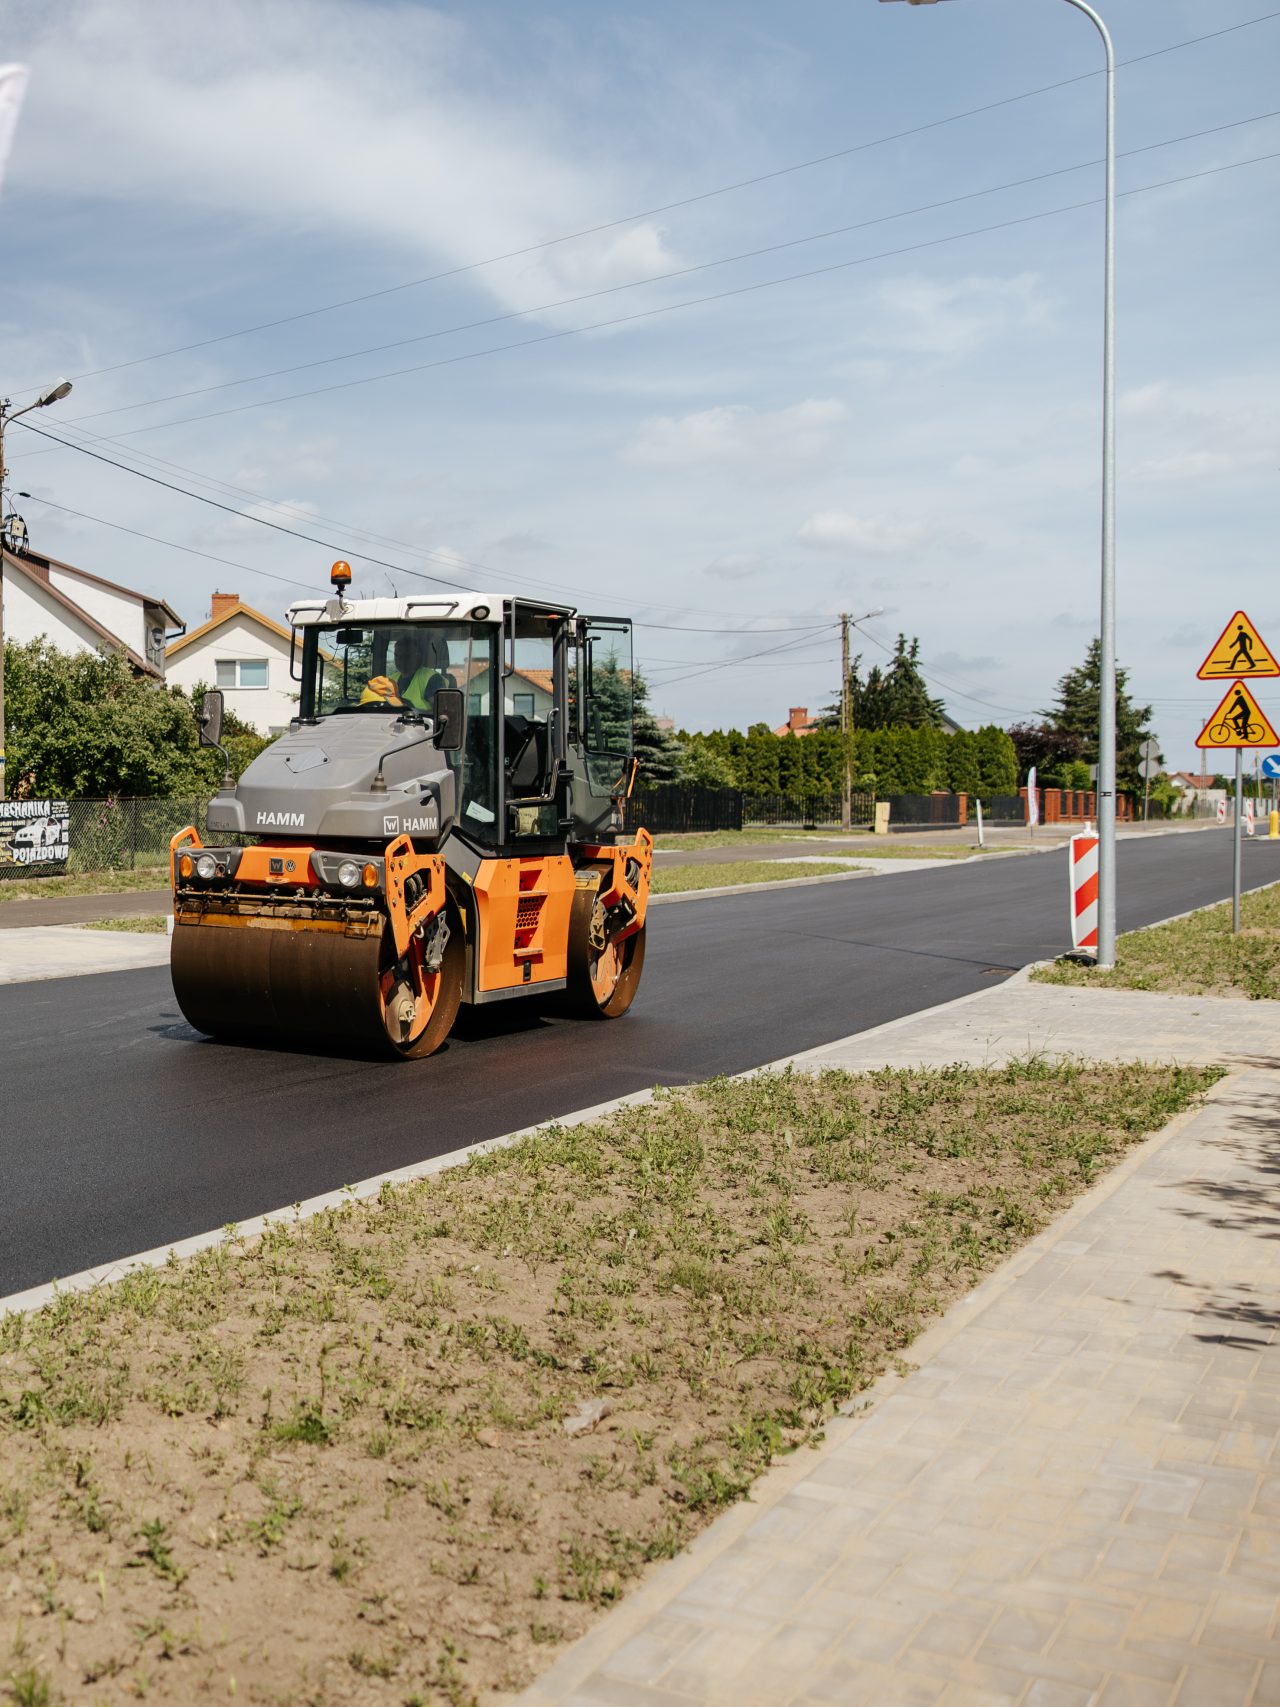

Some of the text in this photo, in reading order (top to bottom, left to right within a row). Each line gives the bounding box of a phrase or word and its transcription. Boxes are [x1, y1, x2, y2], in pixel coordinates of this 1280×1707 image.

[256, 811, 305, 827] HAMM
[403, 817, 437, 831] HAMM
[13, 845, 69, 864] POJAZDOWA
